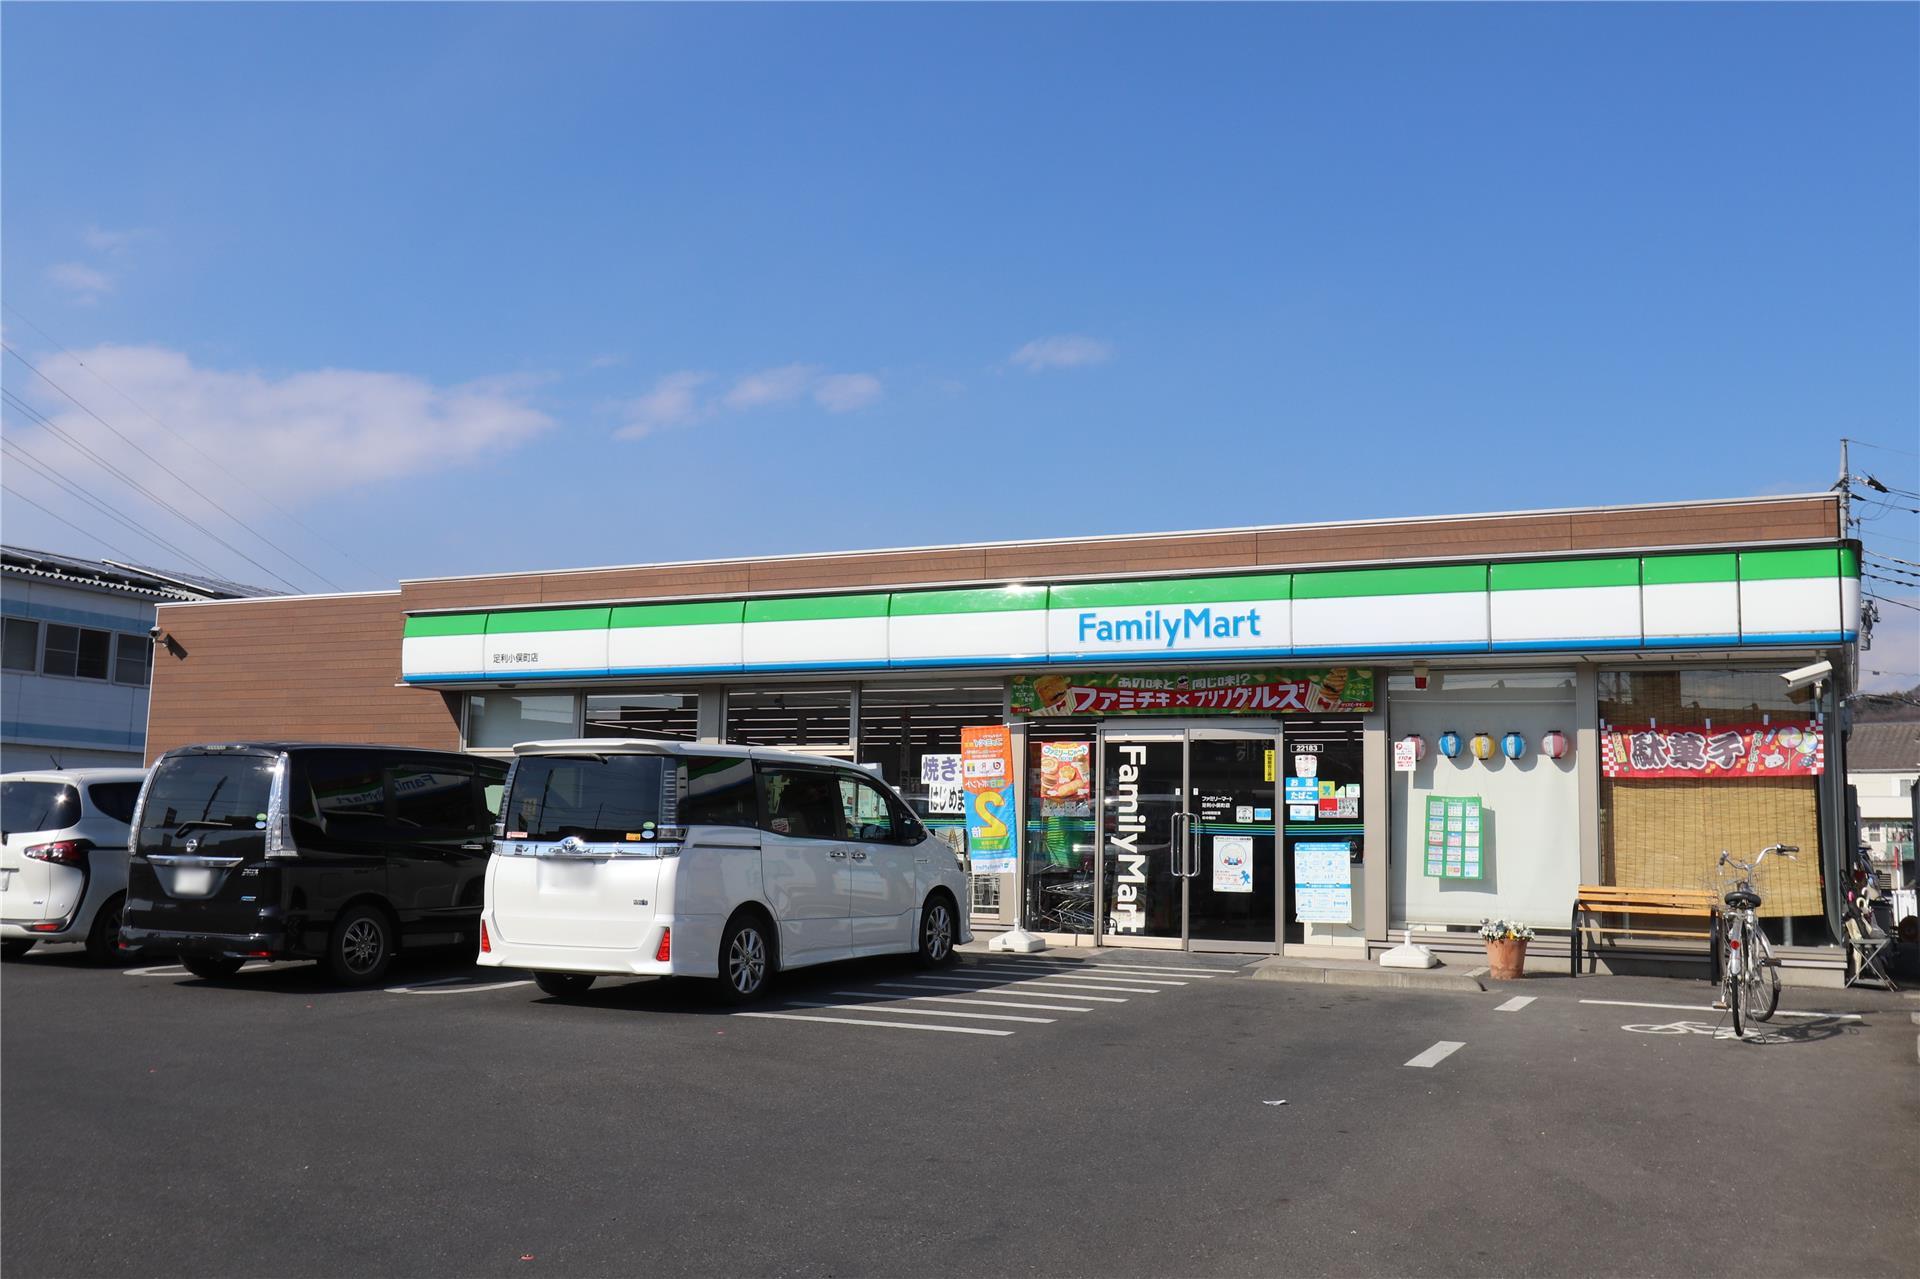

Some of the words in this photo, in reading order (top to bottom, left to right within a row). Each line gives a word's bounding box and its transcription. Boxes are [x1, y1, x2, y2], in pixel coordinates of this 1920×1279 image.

[1078, 607, 1262, 648] FamilyMart
[923, 757, 962, 782] 焼き
[1630, 730, 1746, 769] 駄菓子
[1110, 745, 1147, 933] FamilyMart
